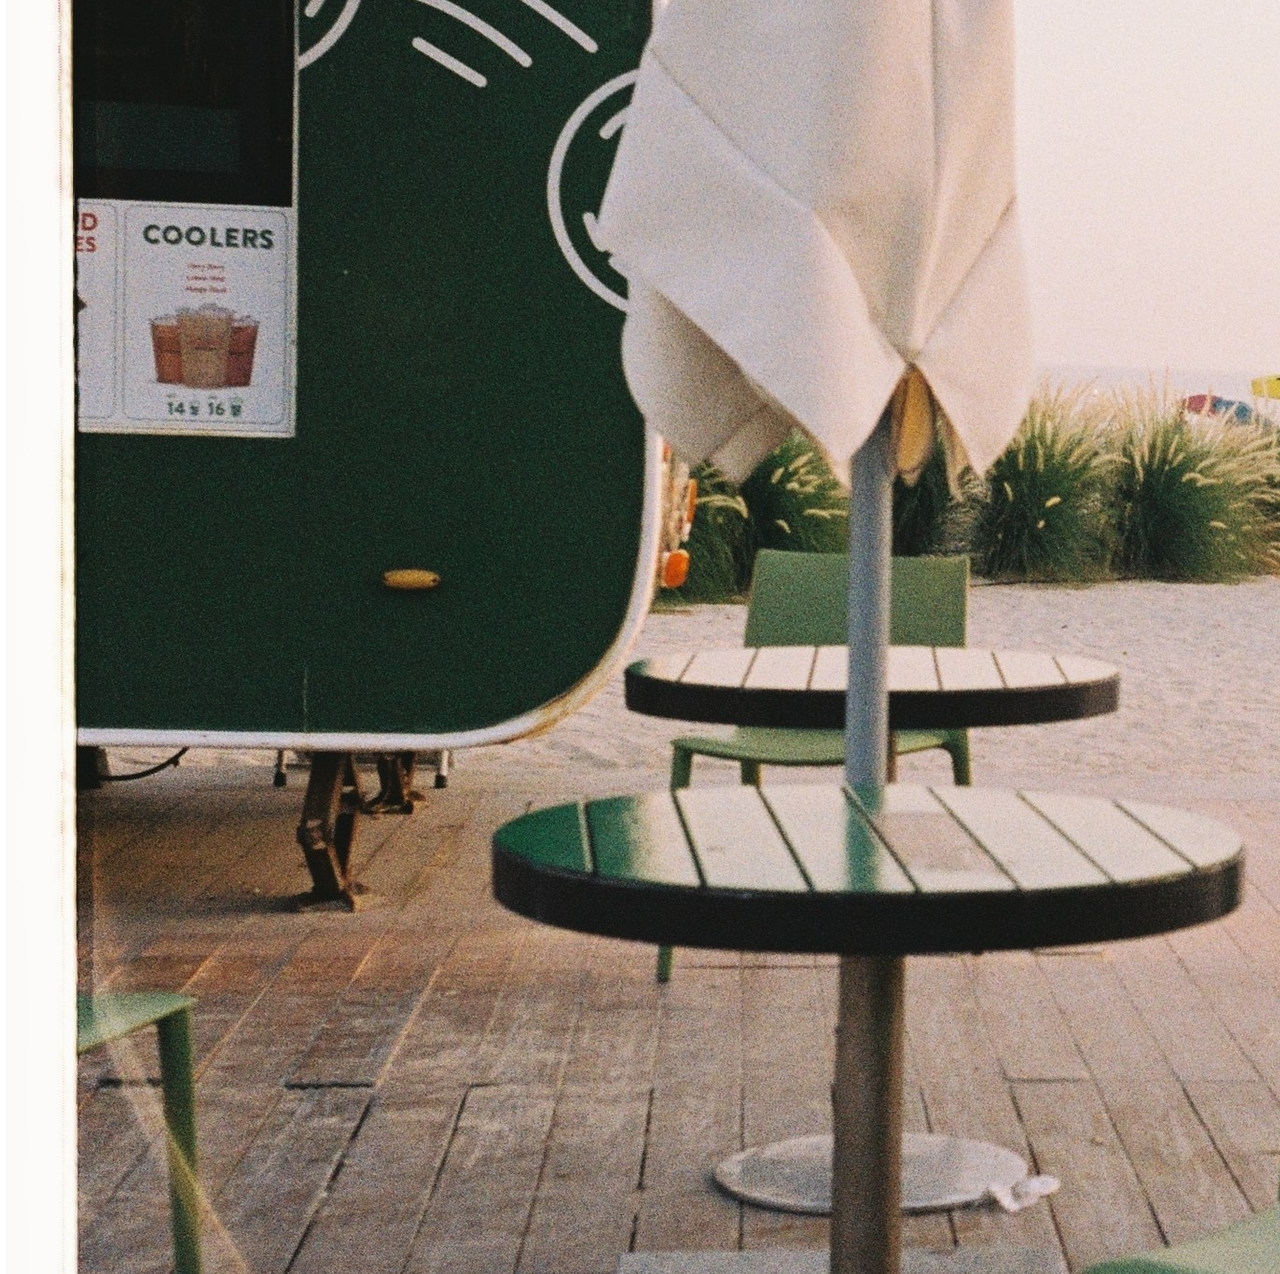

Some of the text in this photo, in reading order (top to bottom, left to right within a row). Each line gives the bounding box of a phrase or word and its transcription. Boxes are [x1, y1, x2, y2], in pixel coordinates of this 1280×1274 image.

[143, 224, 274, 250] COOLERS
[168, 401, 226, 416] 14 16
